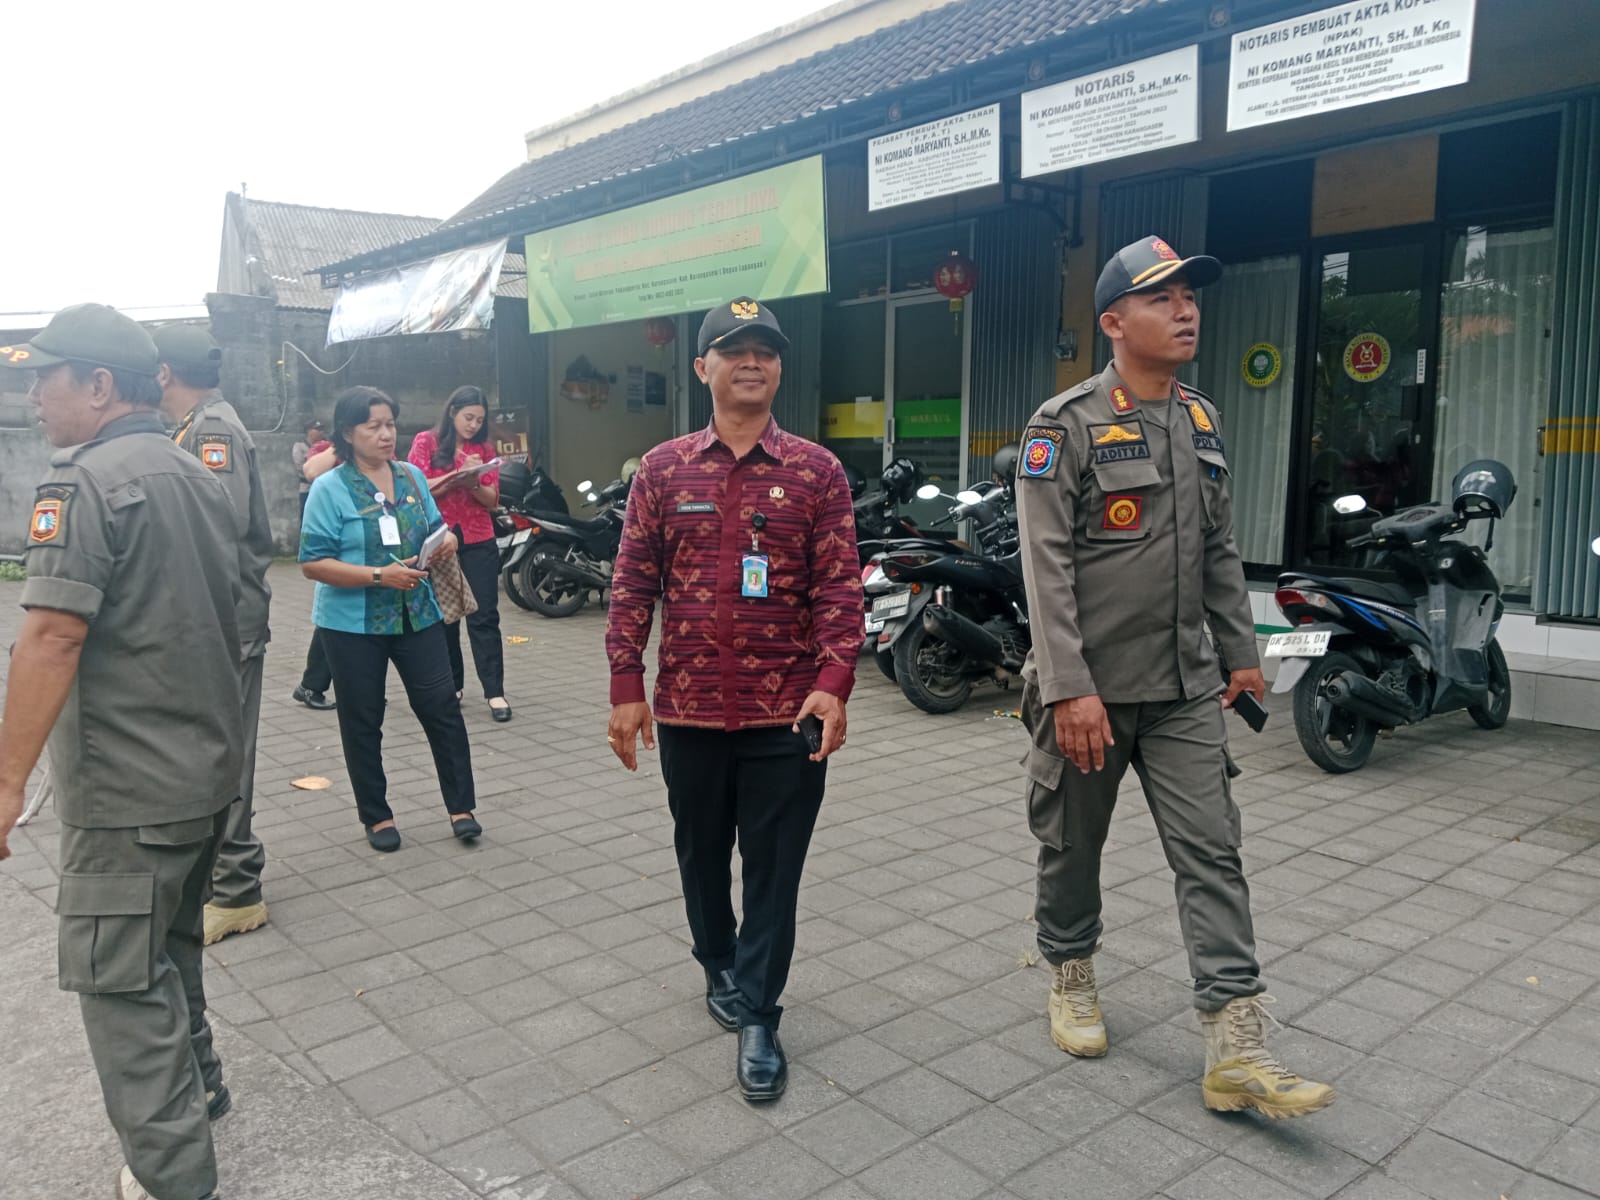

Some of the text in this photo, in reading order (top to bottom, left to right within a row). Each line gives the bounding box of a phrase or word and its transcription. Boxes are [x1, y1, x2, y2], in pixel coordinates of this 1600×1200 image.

[1239, 28, 1289, 51] NOTARIS
[1293, 12, 1351, 38] PEMBUAT
[1355, 2, 1389, 22] AKTA
[1323, 27, 1363, 44] (NPAK)
[1247, 20, 1450, 77] NI KOMANG MARYANTI, SH. M. Kn
[1075, 70, 1135, 96] NOTARIS
[1296, 80, 1332, 92] TANGGAL
[1346, 71, 1366, 81] JULI
[1029, 111, 1039, 121] NI
[1041, 100, 1081, 118] KOMANG
[1083, 87, 1136, 107] MARYANTI,
[906, 122, 940, 137] PEMBUAT
[943, 116, 964, 127] AKTA
[875, 155, 882, 165] NI
[884, 147, 913, 163] KOMANG
[914, 136, 952, 155] MARYANTI,
[1100, 445, 1146, 460] ADITYA
